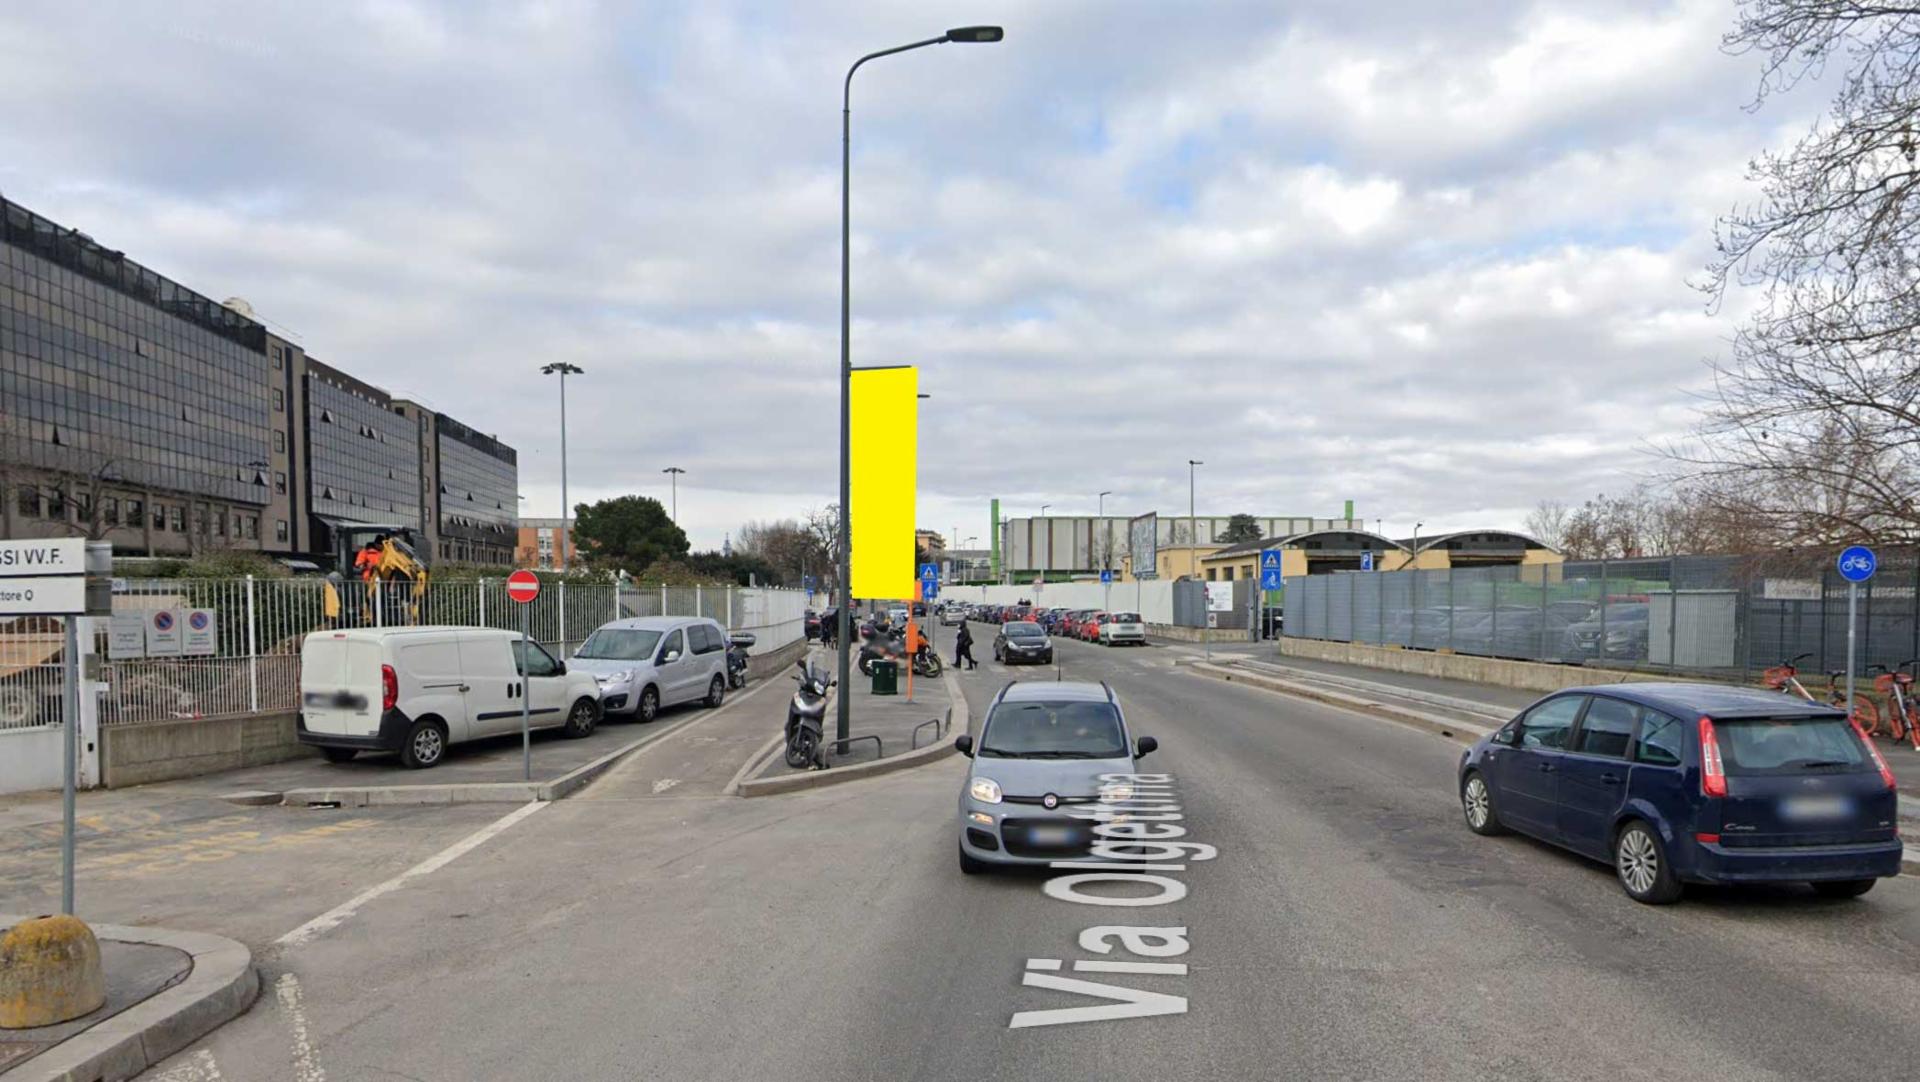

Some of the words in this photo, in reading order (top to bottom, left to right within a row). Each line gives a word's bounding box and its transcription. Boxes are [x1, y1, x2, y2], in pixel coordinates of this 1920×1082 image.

[0, 549, 19, 565] SI
[24, 548, 64, 565] VV.F.
[0, 591, 22, 601] tore
